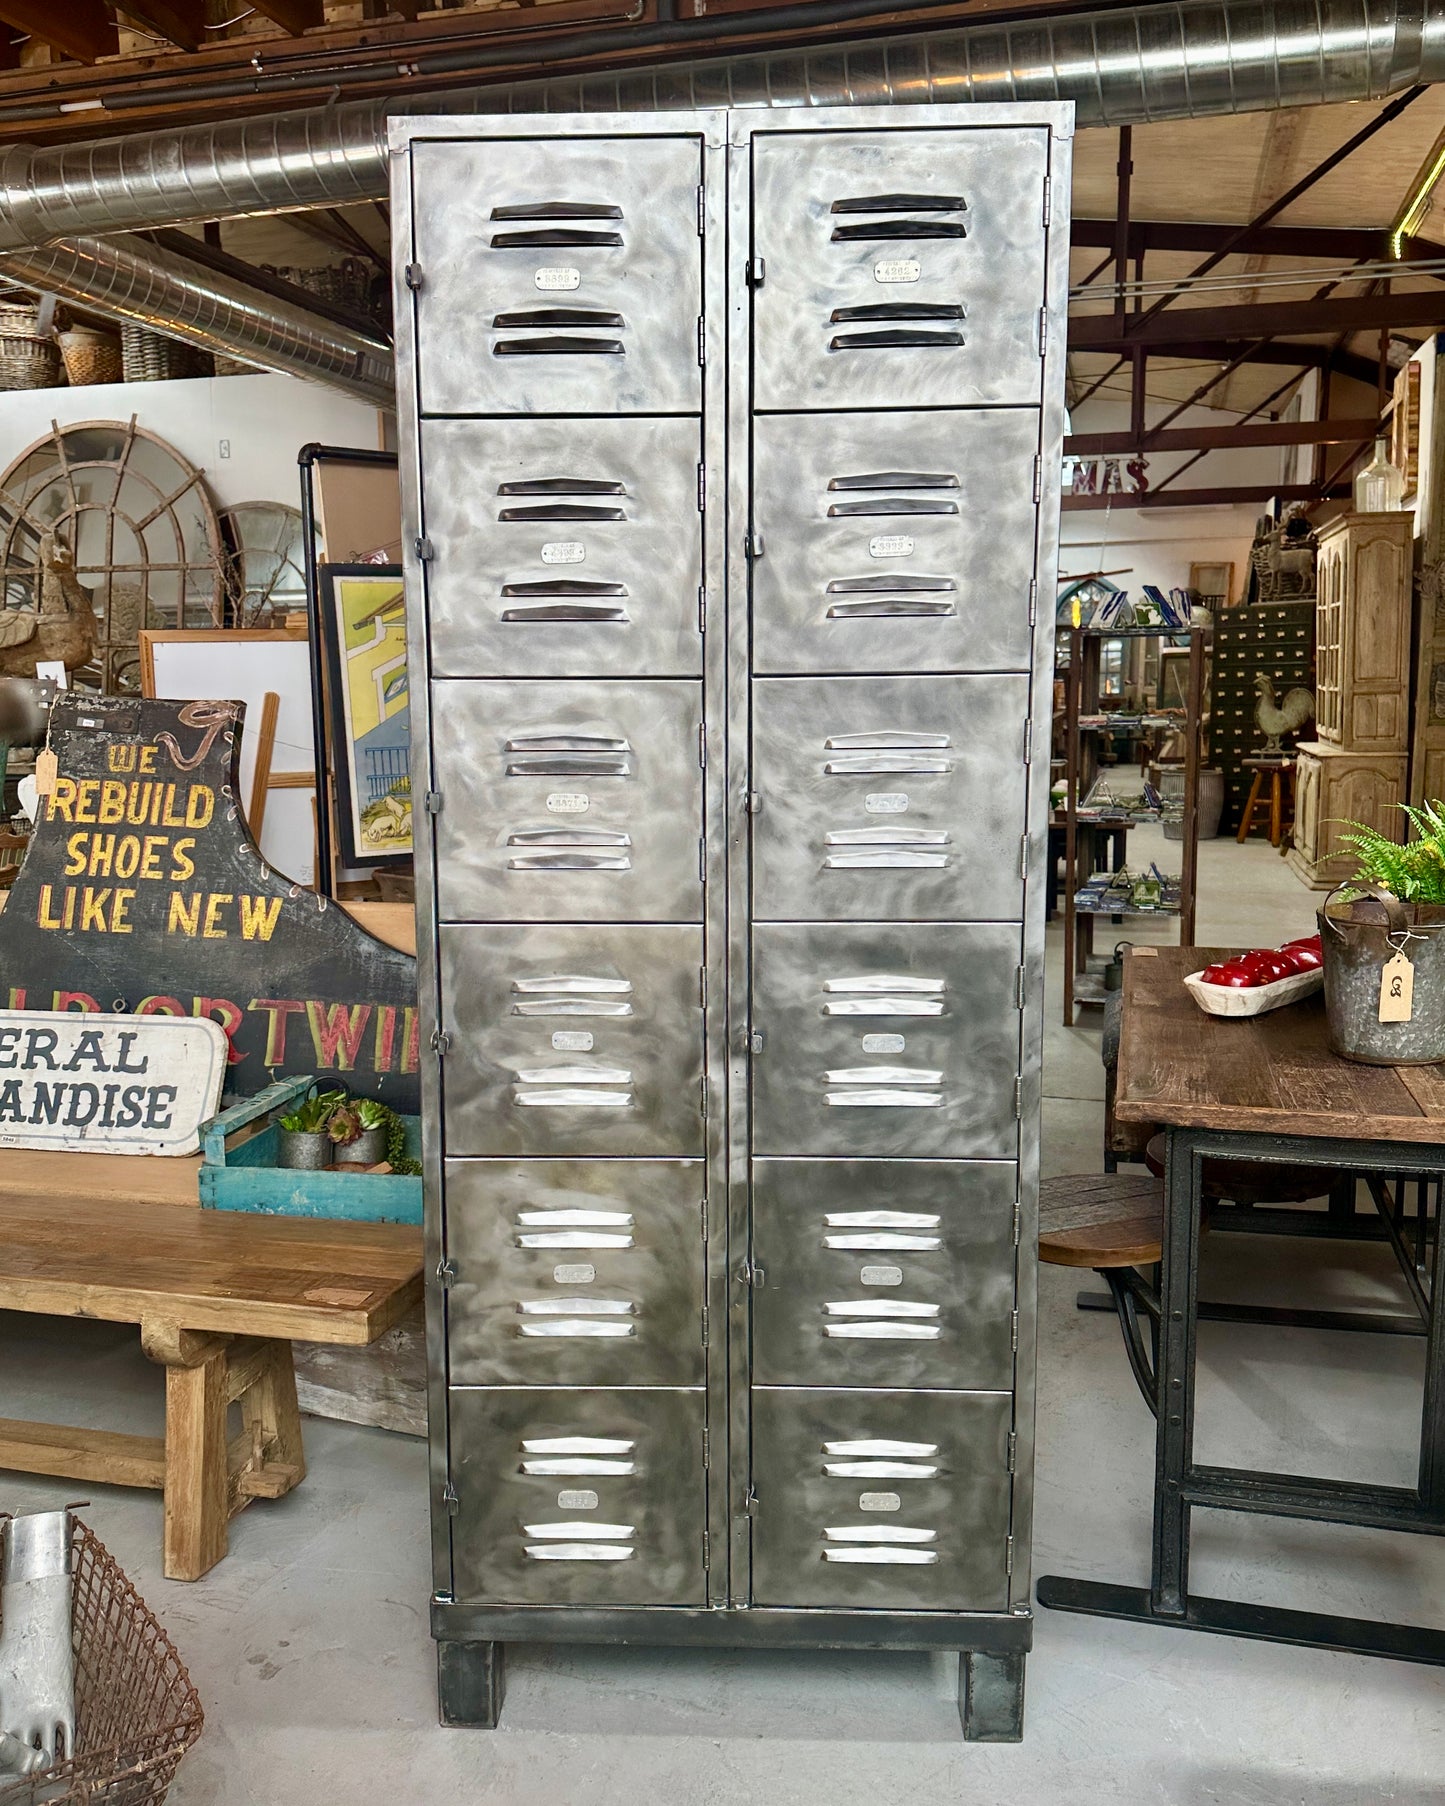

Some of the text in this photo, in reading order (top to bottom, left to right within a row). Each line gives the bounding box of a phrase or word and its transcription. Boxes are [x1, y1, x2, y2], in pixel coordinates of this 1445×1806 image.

[1064, 459, 1150, 496] MAS
[108, 744, 159, 774] WE
[46, 778, 215, 829] REBUILD
[64, 832, 196, 881] SHOES
[37, 884, 283, 942] LIKE NEW
[0, 1027, 149, 1074] ERAL
[0, 1079, 178, 1129] ANDISE
